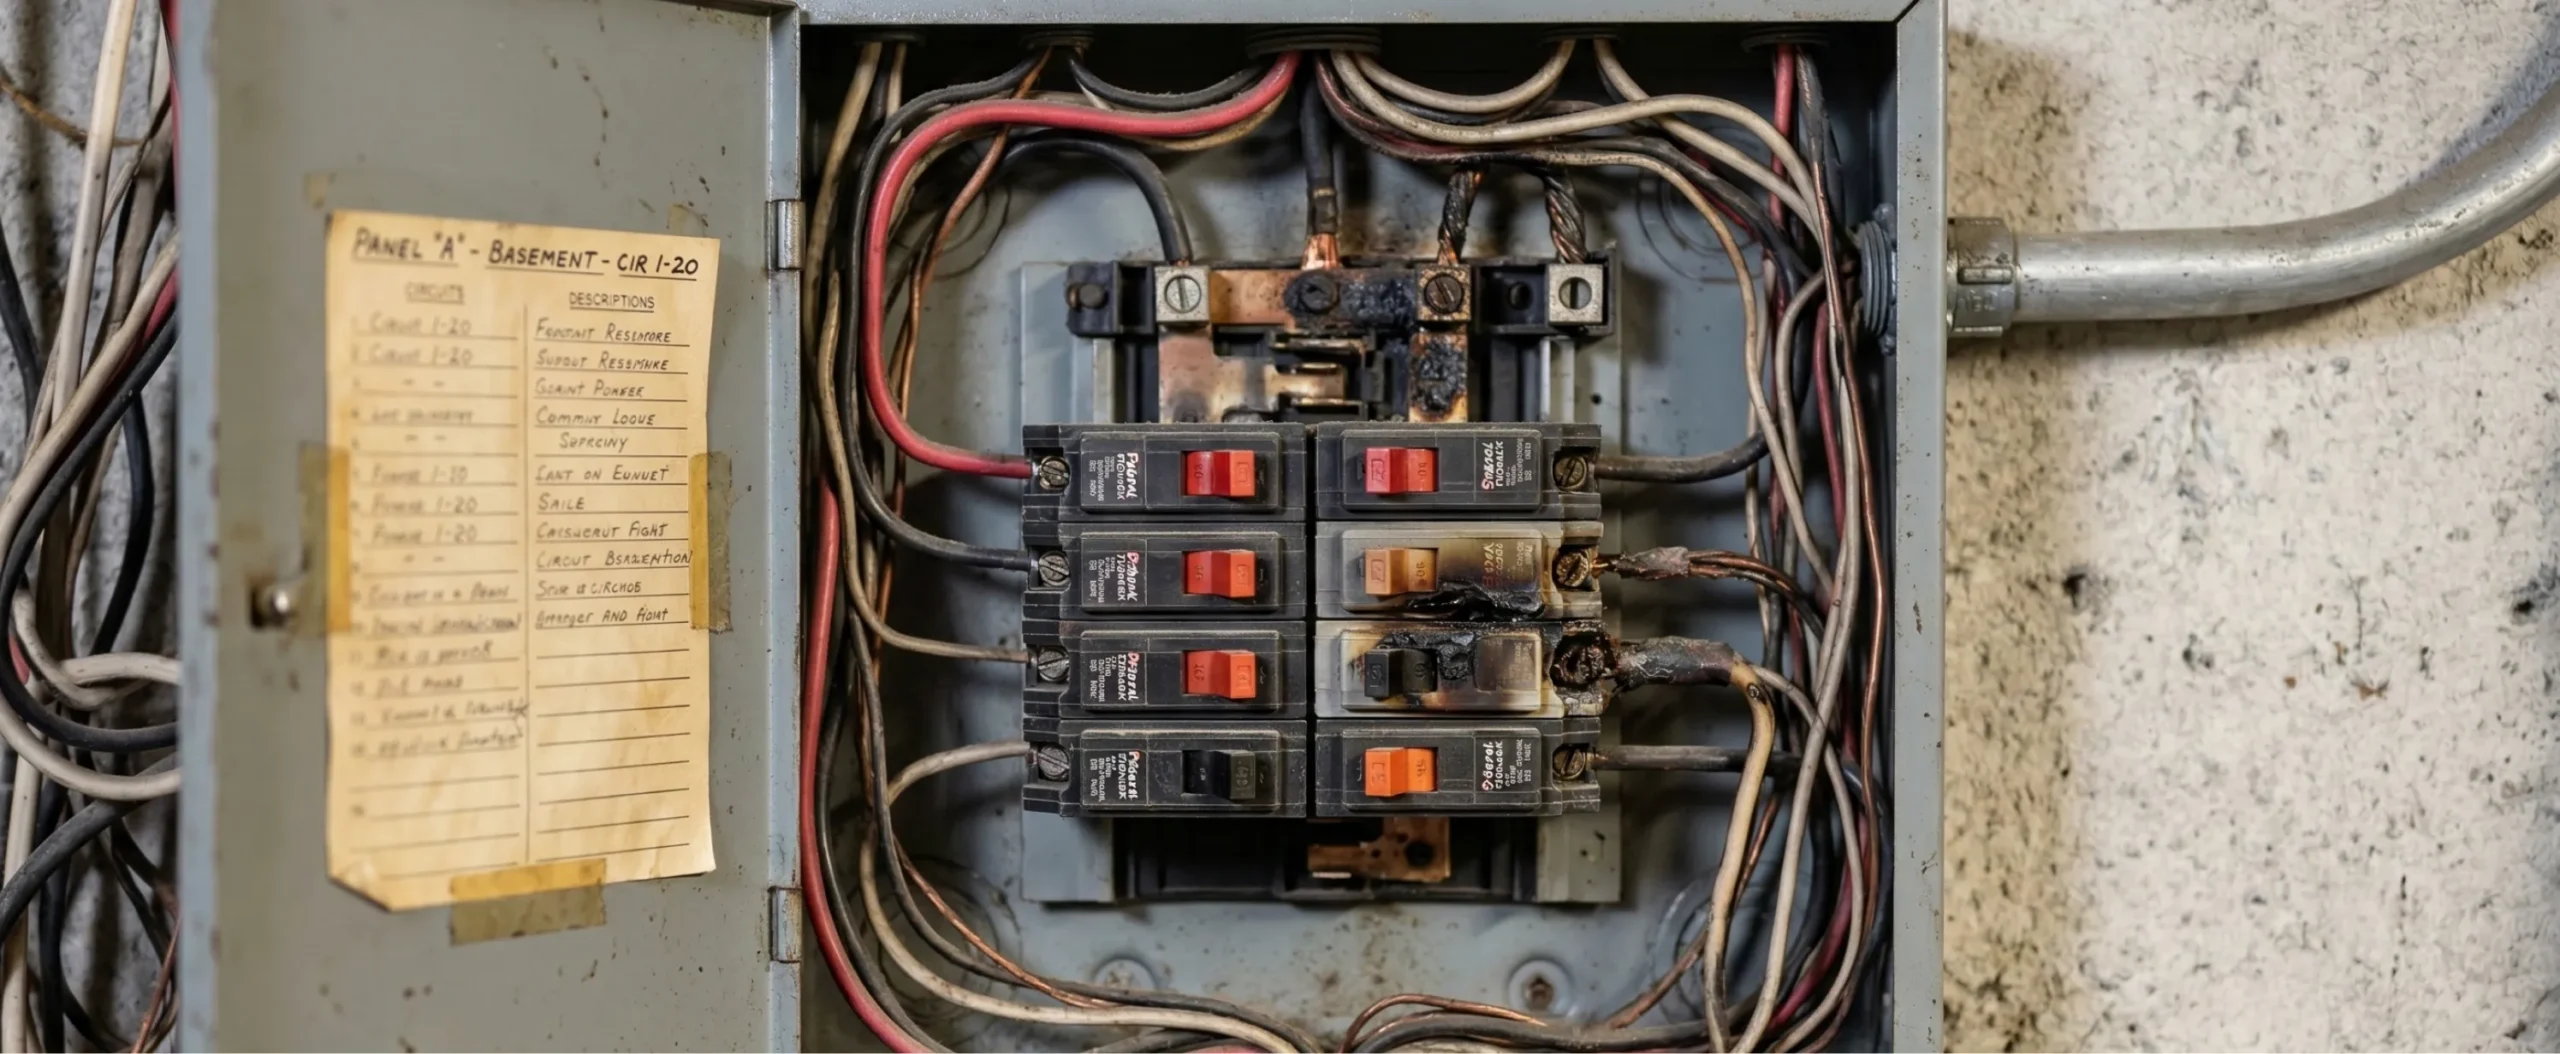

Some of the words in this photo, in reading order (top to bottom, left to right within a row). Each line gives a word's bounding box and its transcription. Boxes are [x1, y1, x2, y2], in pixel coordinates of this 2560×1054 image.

[353, 226, 422, 260] PANEL
[434, 231, 465, 260] "A"
[488, 239, 599, 269] BASEMENT
[617, 253, 648, 274] CIR
[656, 254, 698, 275] 1-20
[569, 291, 655, 309] DESCRIPTIONS
[602, 610, 628, 623] AND
